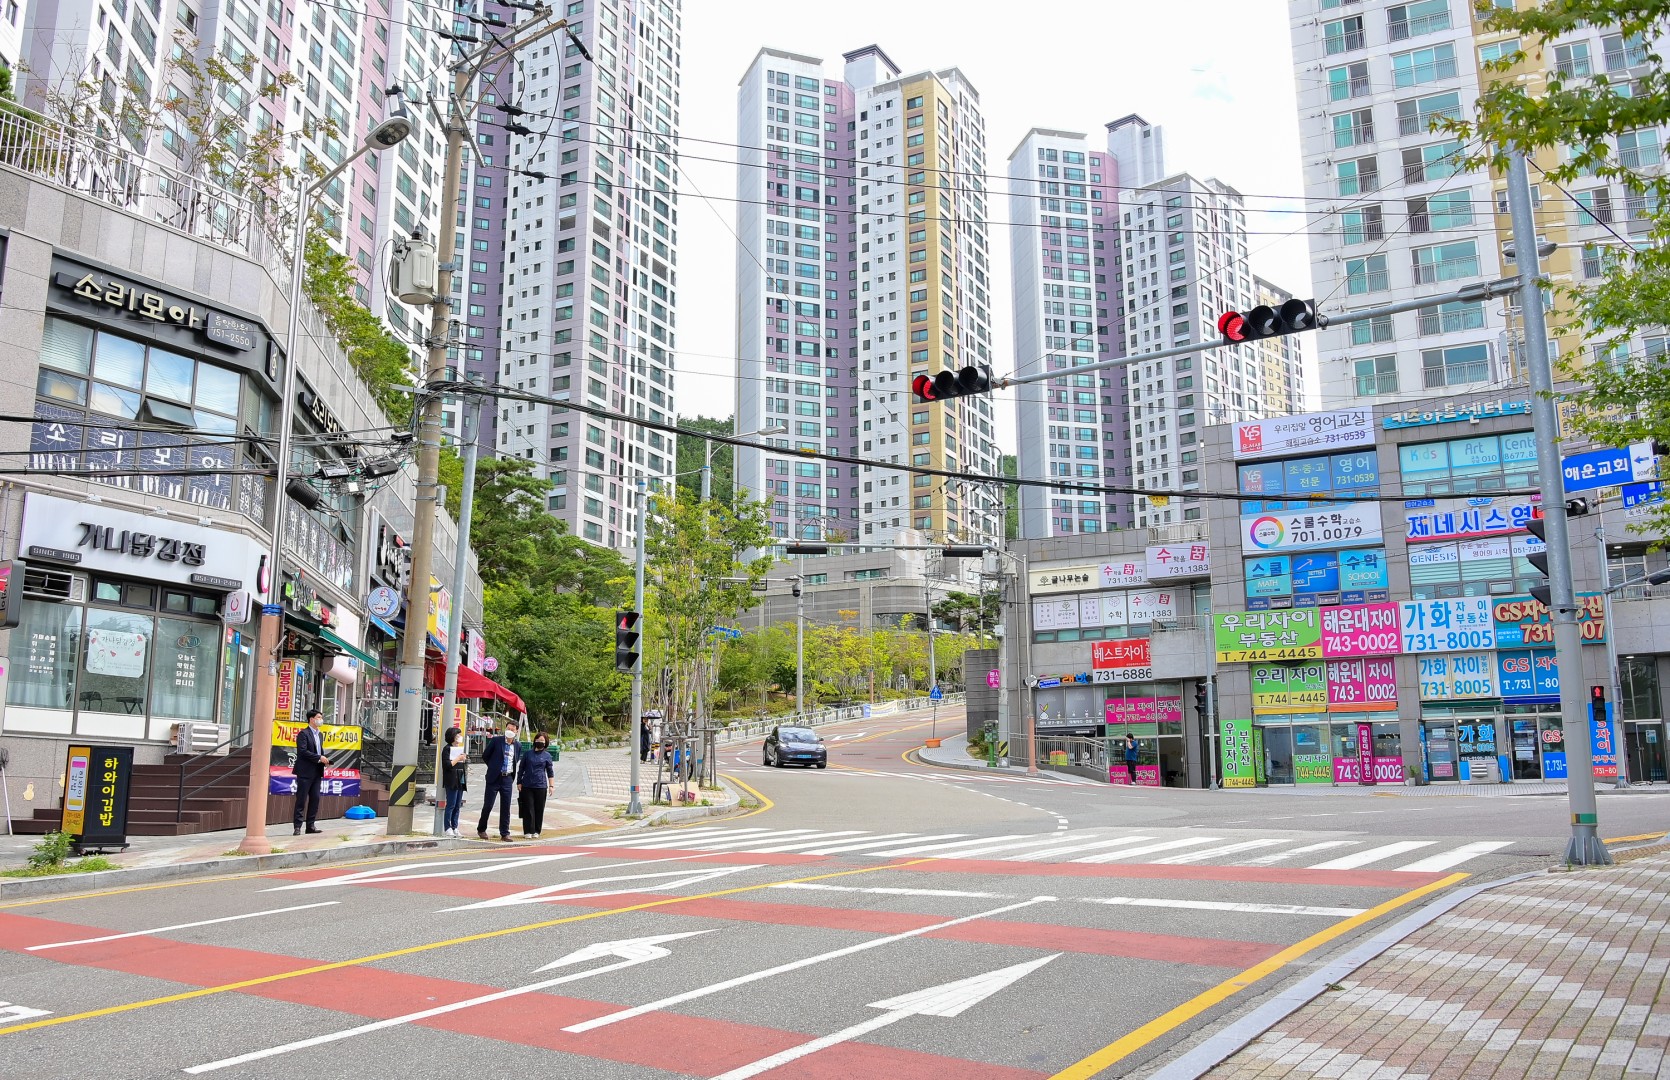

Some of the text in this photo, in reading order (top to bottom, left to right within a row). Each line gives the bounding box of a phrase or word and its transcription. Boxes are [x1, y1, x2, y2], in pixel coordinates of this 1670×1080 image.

[74, 273, 200, 328] 소리모아
[215, 316, 249, 335] 음악학원
[211, 326, 250, 346] 751-2550
[1391, 399, 1503, 425] 키즈아트센터
[1274, 411, 1366, 434] 우리집앞 영어교실
[1240, 425, 1261, 441] YES
[1324, 430, 1366, 443] 731-0539
[46, 423, 225, 486] 소리모아
[1465, 443, 1484, 455] Art
[1505, 437, 1537, 451] Cente
[1339, 456, 1370, 472] 영어
[1482, 454, 1498, 463] 010
[1564, 457, 1629, 481] 해운교회
[1300, 477, 1320, 488] 전문
[1336, 473, 1375, 485] 731-0539
[1290, 513, 1342, 530] 스쿨수학
[1291, 526, 1363, 543] 701.0079
[33, 547, 57, 557] SINCE
[1156, 547, 1186, 563] 수학을
[1410, 553, 1457, 563] GENESIS
[1169, 564, 1209, 574] 731.1383
[1252, 561, 1282, 578] 스쿨
[1346, 554, 1378, 571] 수학
[1107, 575, 1143, 585] 731.1383
[1257, 579, 1279, 588] MATH
[1348, 571, 1381, 580] SCHOOL
[1132, 593, 1171, 606] 수 꿈
[1108, 611, 1122, 619] 수학
[1132, 609, 1172, 619] 731.1383
[1221, 610, 1314, 632] 우리자이
[1324, 607, 1397, 634] 해운대자이
[1404, 600, 1487, 631] 가화 자이
[1455, 612, 1488, 623] 부동산
[1238, 631, 1299, 648] 부동산
[1404, 630, 1493, 651] 731-8005
[1520, 623, 1555, 643] 731
[1325, 633, 1398, 653] 743-0002
[1093, 645, 1143, 662] 베스트자이
[1222, 648, 1317, 662] T.744-4445
[1327, 661, 1393, 684] 해운대 자이
[1420, 658, 1447, 677] 가화
[1453, 656, 1480, 675] 자이
[1502, 657, 1531, 673] GS
[1095, 668, 1152, 681] 731-6886
[1254, 666, 1324, 684] 우리 자이
[1106, 700, 1182, 714] 베스트 자이 부동산
[277, 725, 359, 743] 가나닭 731-2494
[1458, 723, 1495, 743] 가화
[1542, 730, 1564, 743] GS
[1225, 722, 1251, 775] 우리자이 부동산
[1297, 754, 1329, 763] 우리 자이
[1295, 766, 1331, 779] 744-4445
[1373, 764, 1402, 780] 0002
[1224, 778, 1255, 787] T.744-4445
[99, 757, 119, 827] 하와이김밥
